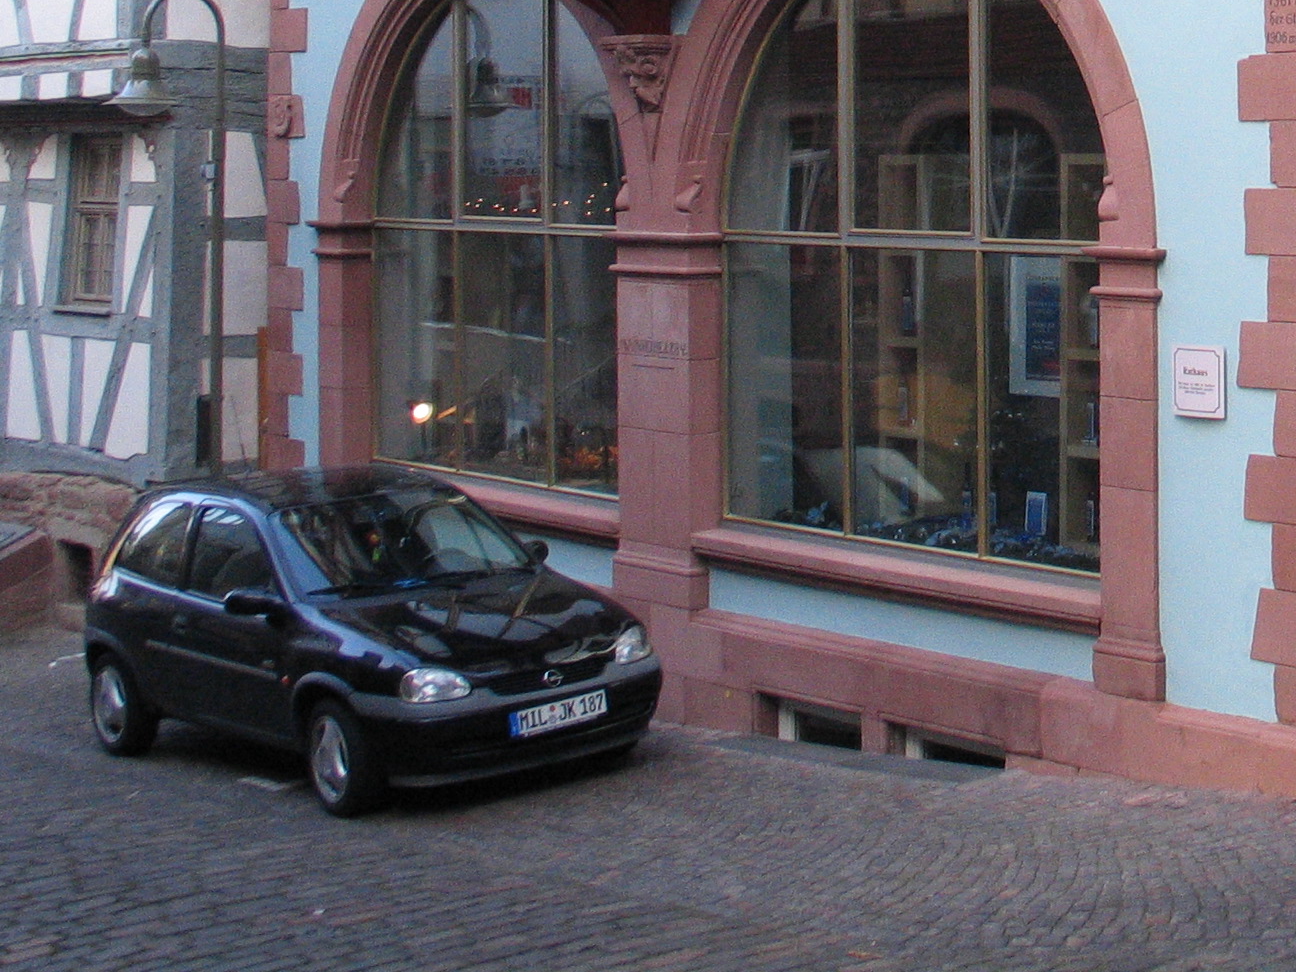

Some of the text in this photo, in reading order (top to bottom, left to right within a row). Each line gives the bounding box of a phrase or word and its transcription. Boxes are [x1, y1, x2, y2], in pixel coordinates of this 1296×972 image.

[519, 693, 604, 731] MIL JK 187
